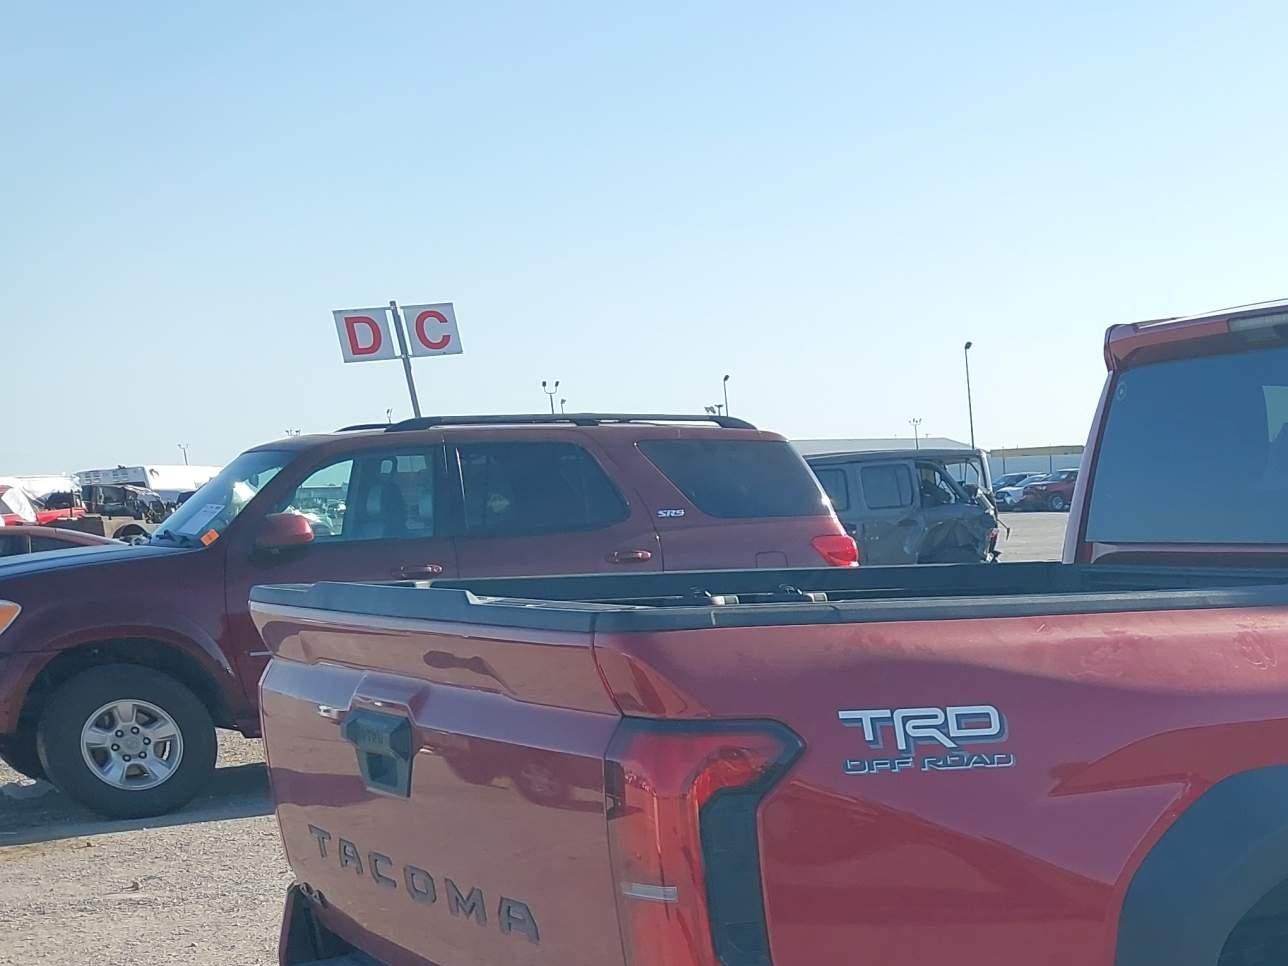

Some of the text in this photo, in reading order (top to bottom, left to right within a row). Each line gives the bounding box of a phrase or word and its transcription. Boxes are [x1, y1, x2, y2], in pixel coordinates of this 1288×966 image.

[343, 315, 382, 356] D
[415, 310, 452, 350] C
[838, 705, 1007, 752] TRD
[843, 751, 1017, 776] OFF ROAD
[308, 823, 541, 946] TACOMA
